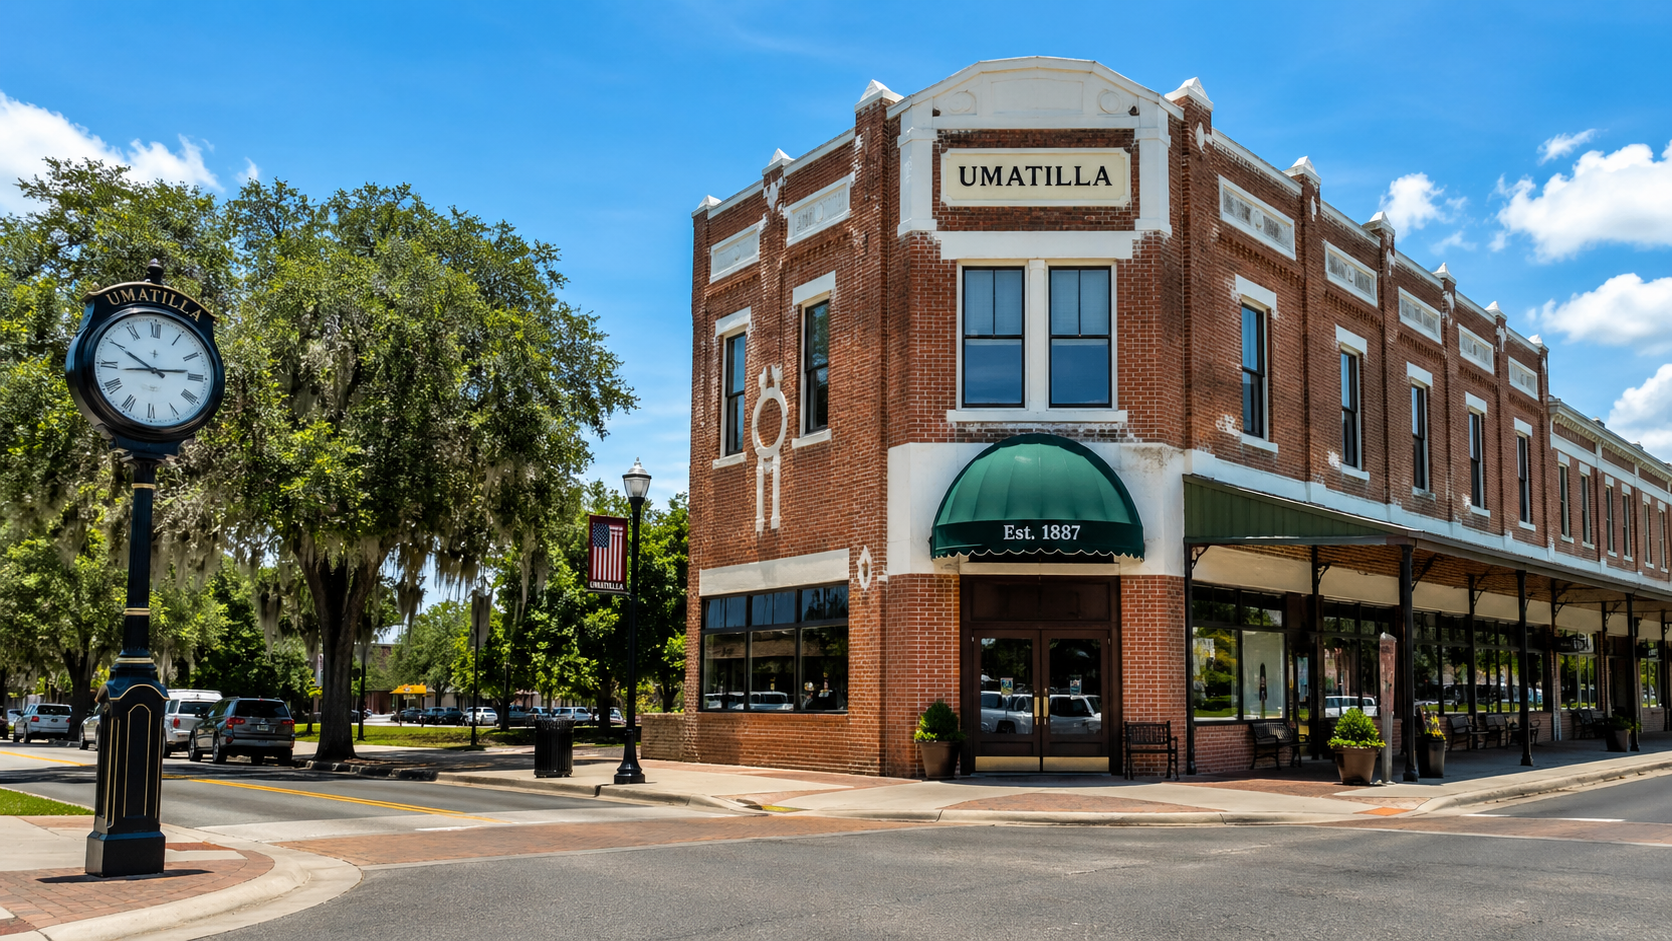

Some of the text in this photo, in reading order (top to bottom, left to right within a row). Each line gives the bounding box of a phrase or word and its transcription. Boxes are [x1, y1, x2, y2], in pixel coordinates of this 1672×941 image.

[958, 165, 1113, 187] UMATILLA
[105, 288, 202, 322] UMATILLA
[1003, 524, 1081, 540] Est. 1887
